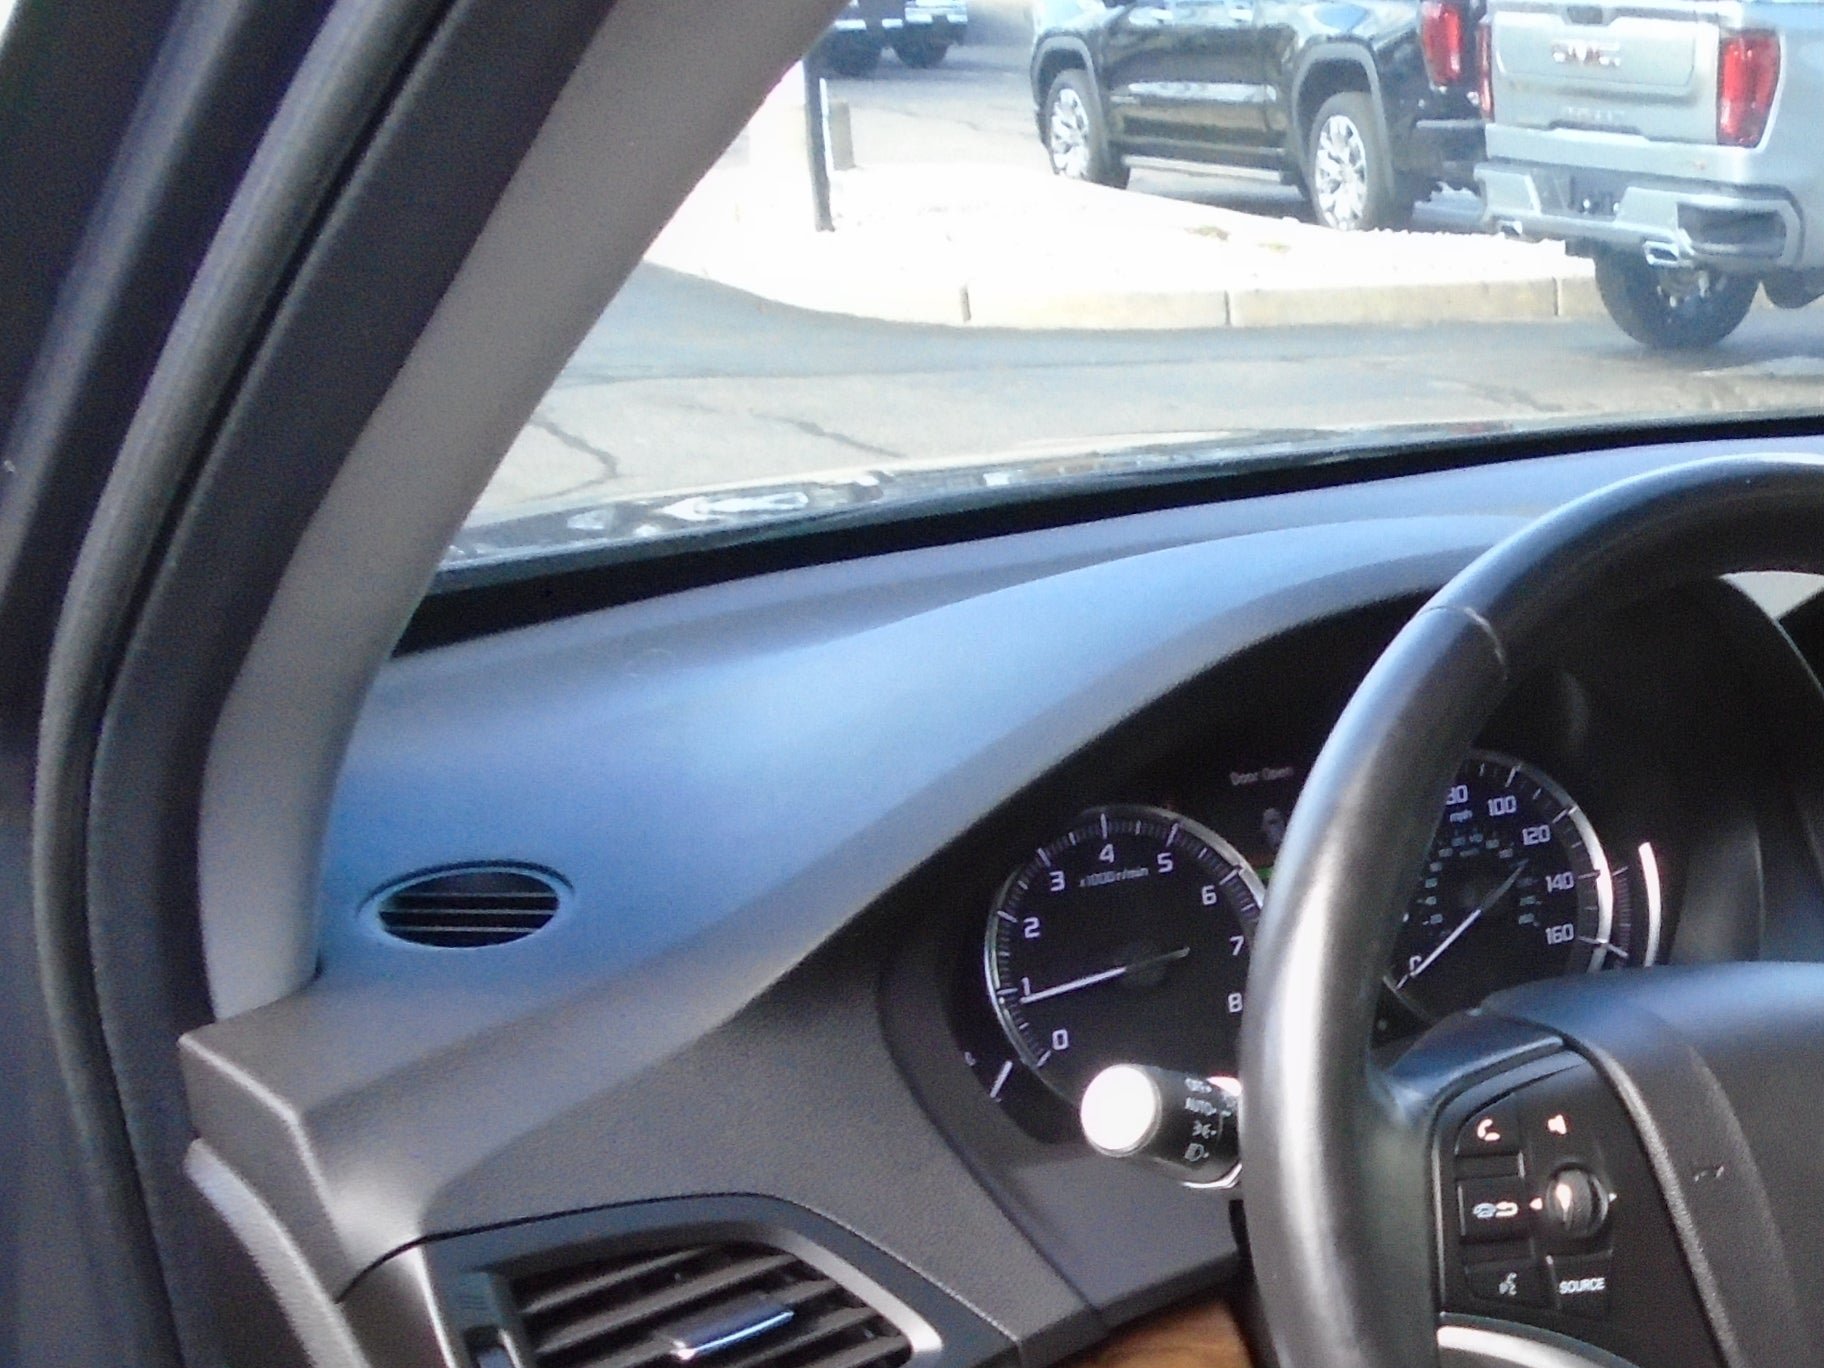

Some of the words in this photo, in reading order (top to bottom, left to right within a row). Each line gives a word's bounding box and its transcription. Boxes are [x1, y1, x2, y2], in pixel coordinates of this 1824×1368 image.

[1487, 796, 1517, 817] 100
[1522, 824, 1551, 846] 120
[1099, 843, 1114, 863] 4
[1157, 853, 1173, 873] 5
[1049, 871, 1065, 891] 3
[1545, 871, 1575, 892] 140
[1201, 885, 1217, 905] 6
[1023, 917, 1040, 938] 2
[1545, 923, 1575, 945] 160
[1229, 935, 1245, 956] 7
[1020, 977, 1031, 997] 1
[1227, 992, 1243, 1013] 8
[1051, 1029, 1069, 1050] 0
[1559, 1277, 1605, 1294] SOURCE
